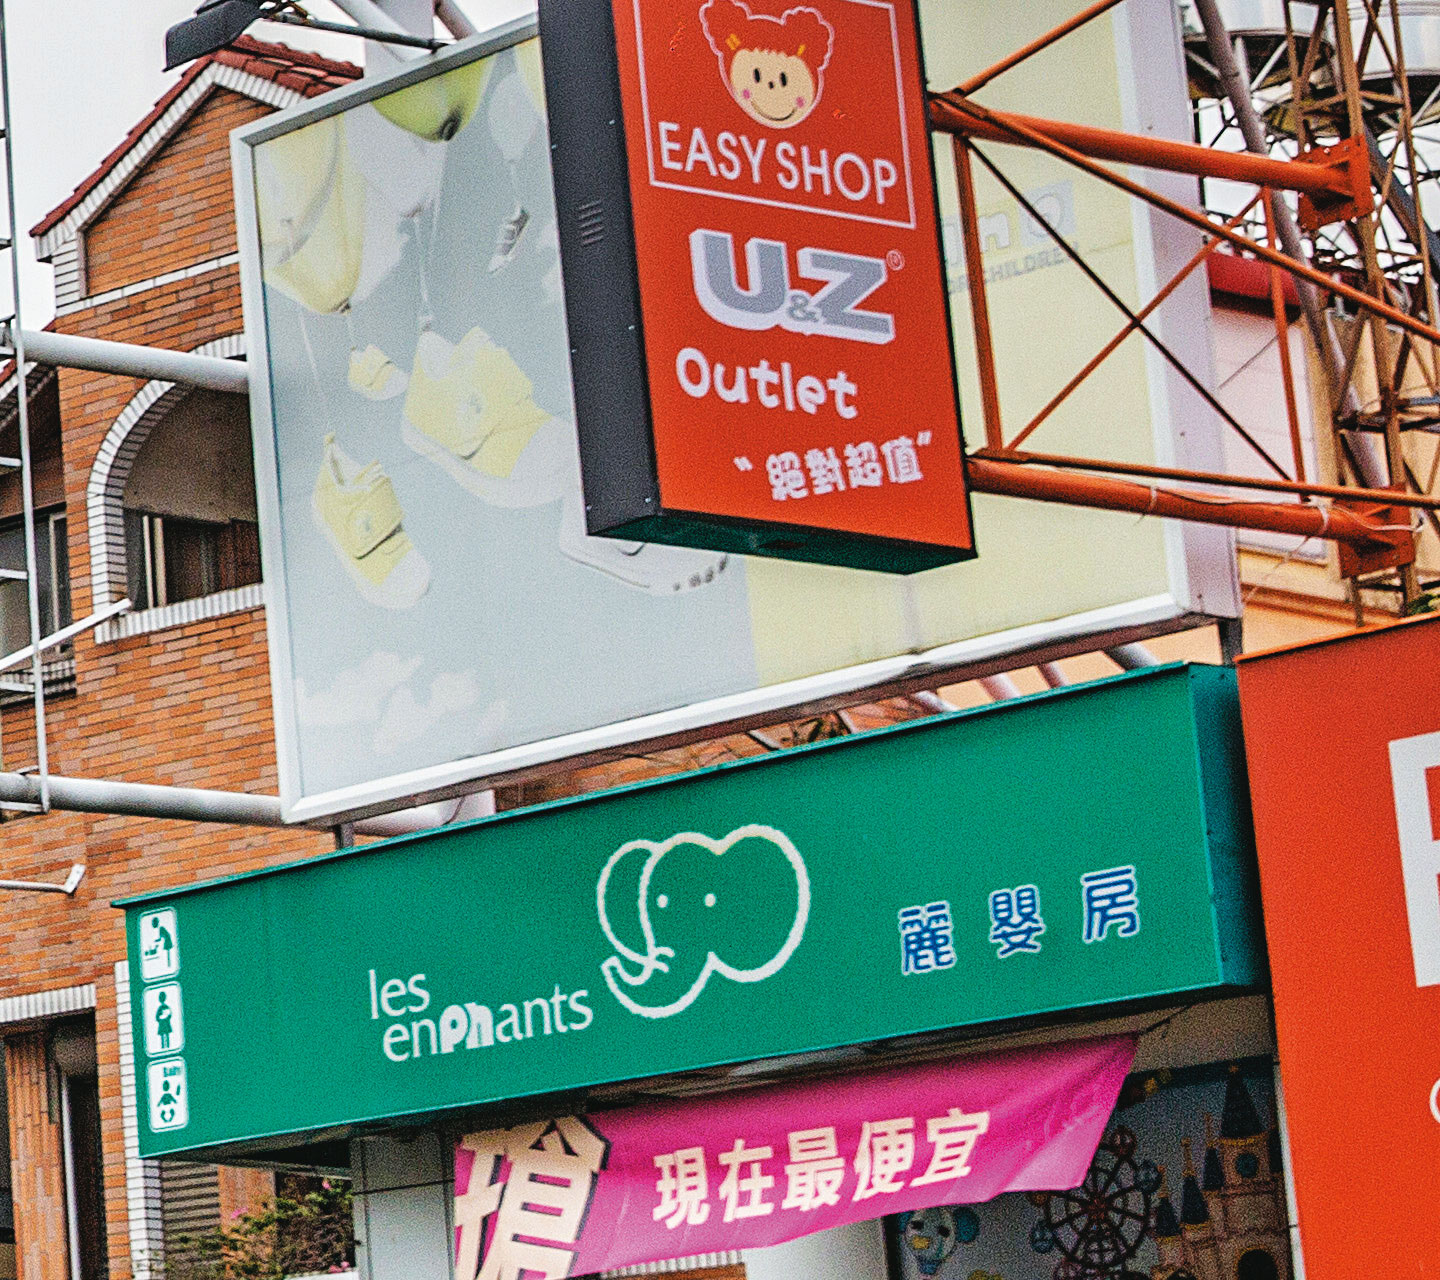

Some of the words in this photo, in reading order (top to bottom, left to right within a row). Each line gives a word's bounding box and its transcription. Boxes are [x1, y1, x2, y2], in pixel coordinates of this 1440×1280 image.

[658, 120, 767, 188] EASY
[775, 140, 899, 206] SHOP
[675, 347, 860, 420] Outlet
[899, 865, 1141, 976] 麗嬰房
[369, 967, 429, 1023] les
[652, 1107, 991, 1230] 現在最便宜
